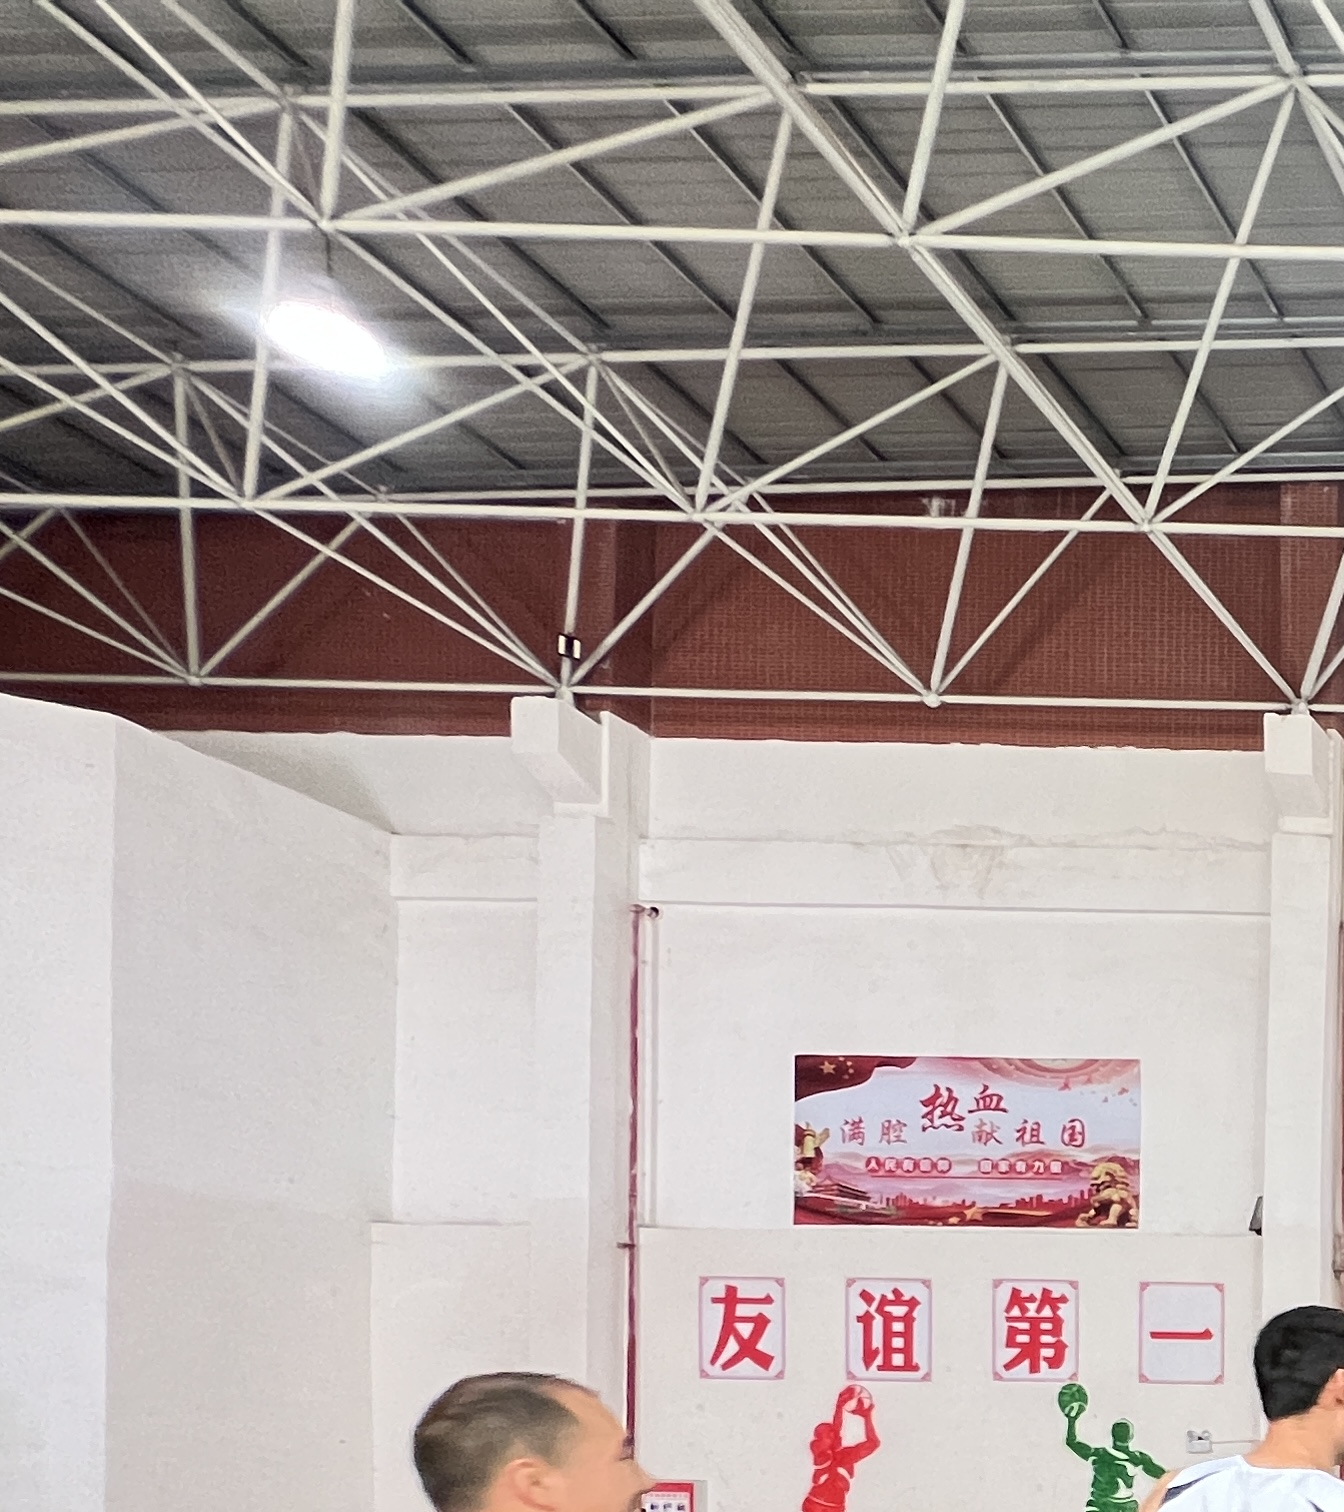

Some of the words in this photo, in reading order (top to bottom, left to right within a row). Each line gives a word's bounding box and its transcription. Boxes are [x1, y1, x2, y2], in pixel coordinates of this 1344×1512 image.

[840, 1114, 908, 1147] 满腔
[919, 1083, 1009, 1133] 热血
[970, 1117, 1087, 1148] 献祖国
[709, 1284, 1214, 1375] 友谊第一
